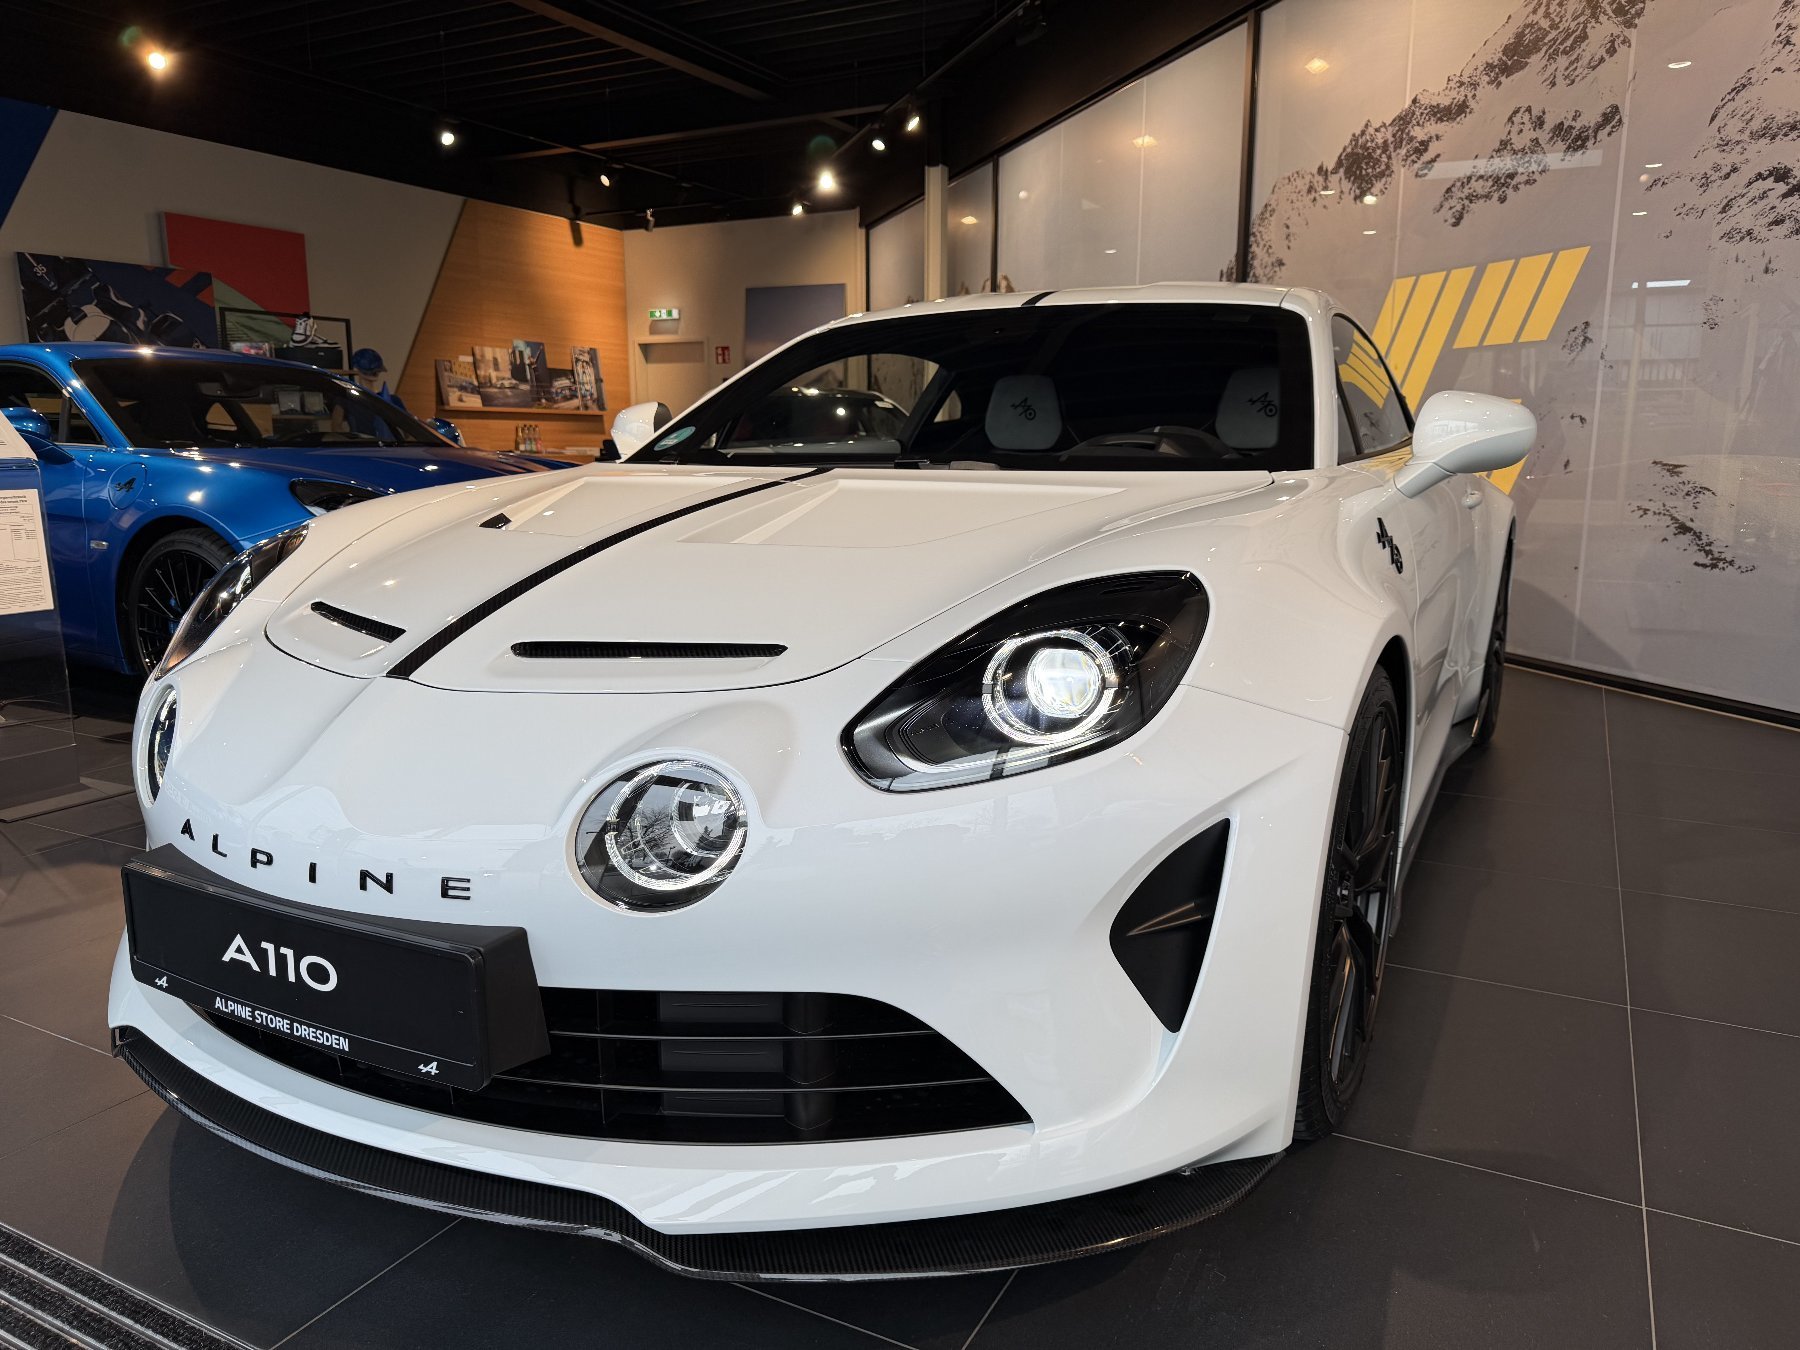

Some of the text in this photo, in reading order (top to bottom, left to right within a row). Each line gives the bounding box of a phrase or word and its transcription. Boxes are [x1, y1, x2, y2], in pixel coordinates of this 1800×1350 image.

[180, 818, 471, 901] ALPINE
[221, 933, 339, 993] A110
[214, 996, 350, 1052] ALPINE STORE DRESDEN
